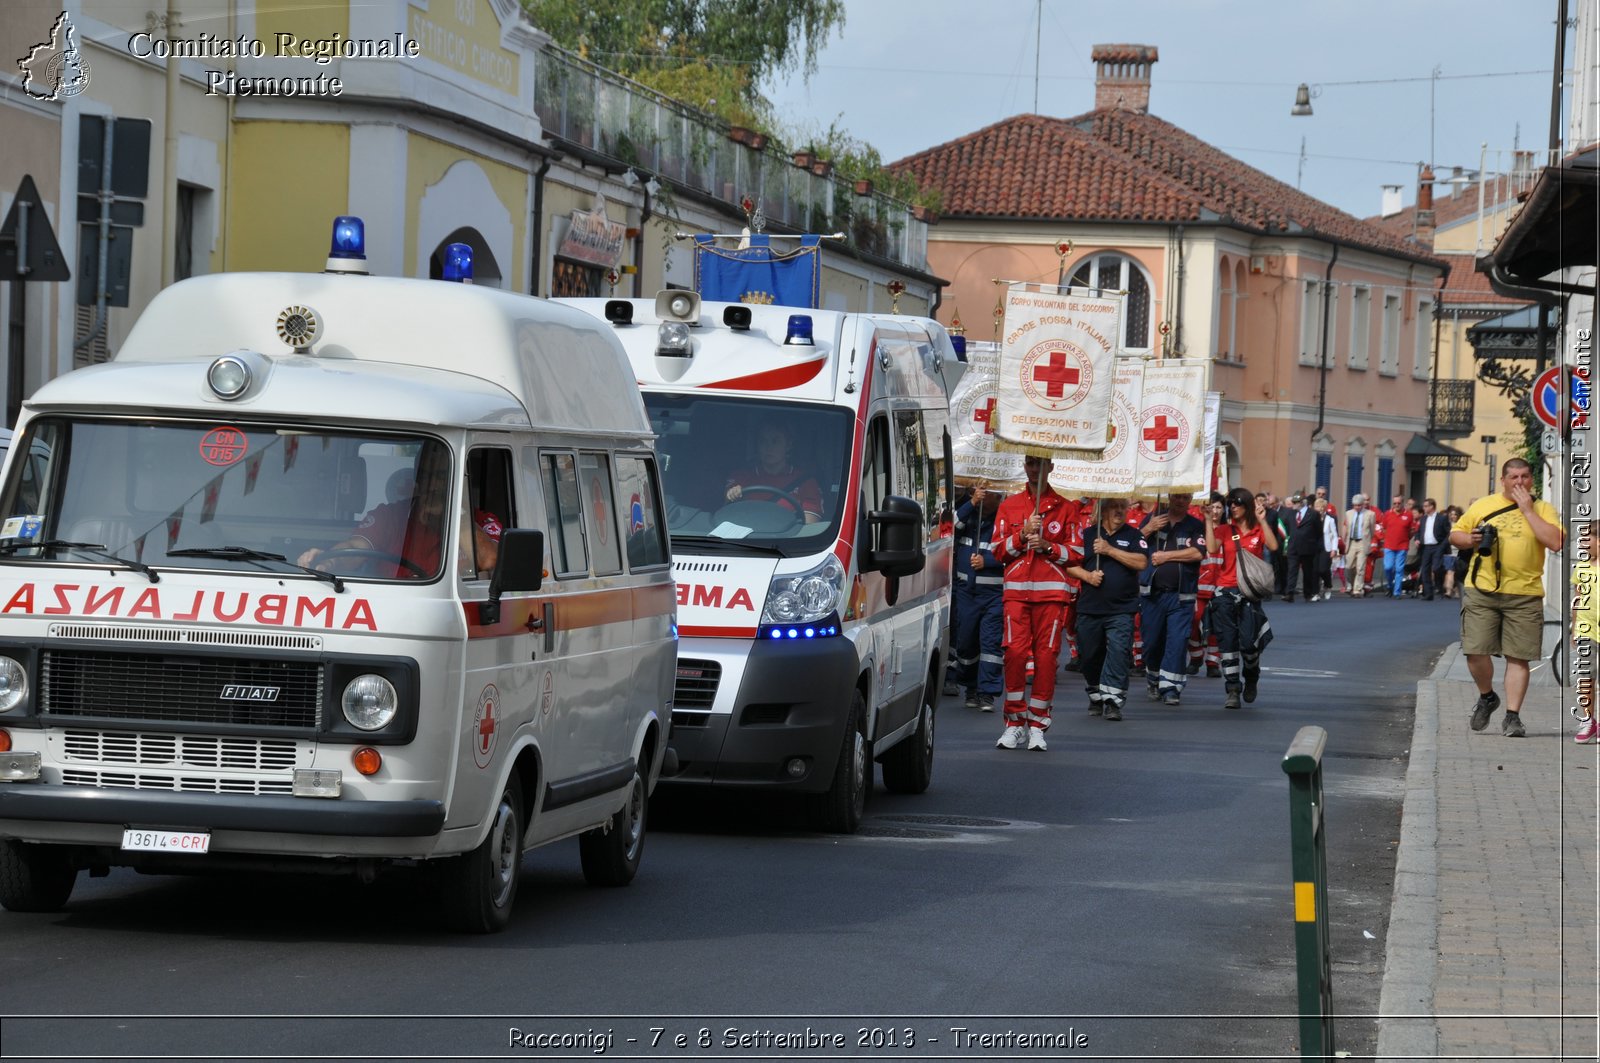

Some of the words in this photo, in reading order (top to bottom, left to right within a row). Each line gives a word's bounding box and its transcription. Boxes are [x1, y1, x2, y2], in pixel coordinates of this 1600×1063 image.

[472, 43, 512, 86] CHICCO
[1011, 297, 1031, 306] CORPO
[1034, 299, 1066, 310] VOLONTARI
[1069, 303, 1079, 312] DEL
[1082, 304, 1114, 314] SOCCORSO
[1007, 321, 1037, 345] CROCE
[1040, 316, 1072, 326] ROSSA
[1077, 321, 1111, 353] ITALIANA
[978, 365, 998, 375] ROSS
[1022, 351, 1037, 399] CONVENZIONE
[1045, 342, 1076, 353] GINEVRA
[1075, 351, 1084, 359] 22
[1081, 359, 1091, 389] AGOSTO
[1113, 390, 1139, 427] ITALIANA
[1012, 415, 1078, 429] DELEGAZIONE
[1082, 421, 1092, 430] DI
[216, 432, 236, 445] CN
[1022, 430, 1077, 444] PAESANA
[209, 447, 234, 461] 015
[954, 455, 986, 465] OMITATO
[988, 457, 1016, 467] LOCALE
[1056, 465, 1092, 474] COMITATO
[1095, 467, 1124, 475] LOCALE
[1050, 472, 1080, 482] BORGO
[1092, 476, 1133, 485] DALMAZZO
[221, 687, 277, 700] FIAT
[128, 833, 167, 848] 13614
[181, 835, 207, 850] CRI
